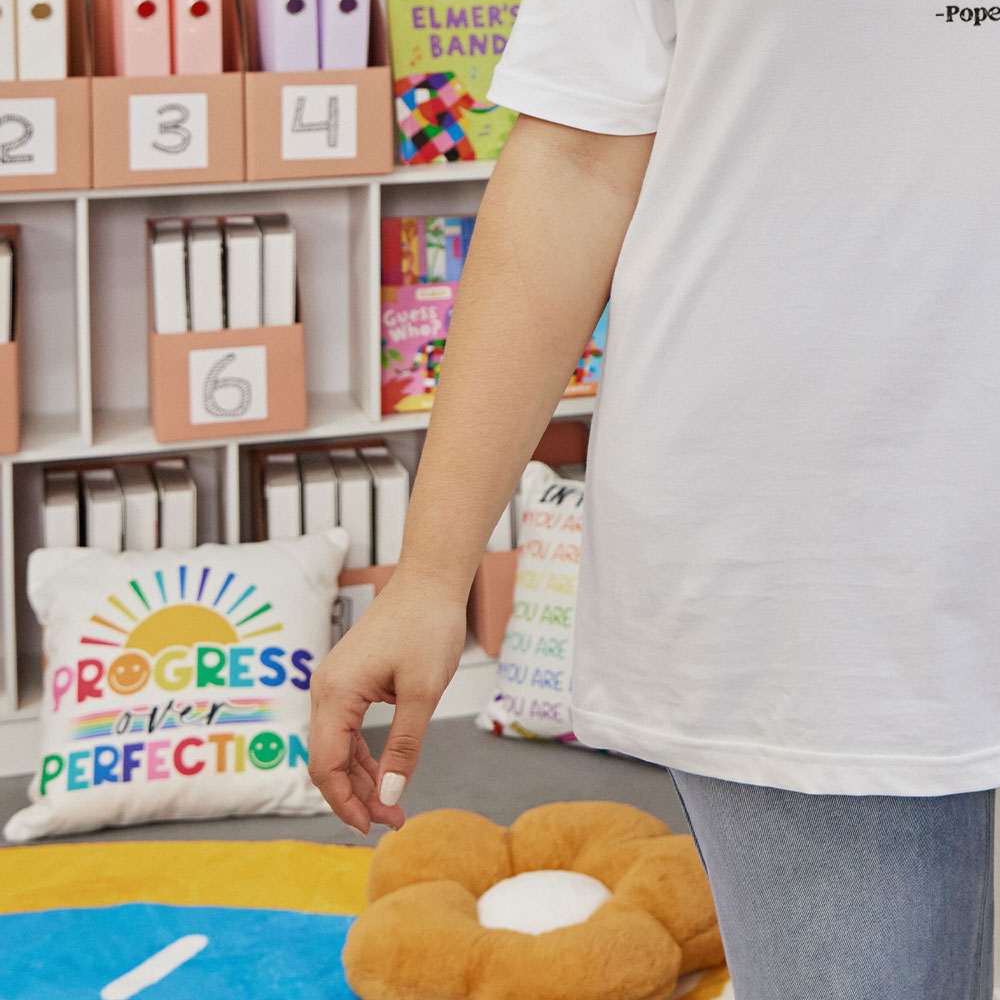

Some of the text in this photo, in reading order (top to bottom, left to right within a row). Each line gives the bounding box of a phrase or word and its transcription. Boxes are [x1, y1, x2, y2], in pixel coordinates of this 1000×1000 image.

[430, 34, 507, 58] BAND
[0, 114, 34, 163] 2
[152, 103, 192, 155] 3
[291, 96, 339, 147] 4
[382, 305, 437, 328] Guess
[388, 320, 442, 343] Who?
[204, 352, 252, 417] 6
[52, 646, 314, 712] PROGRESS
[115, 698, 255, 736] over
[40, 730, 309, 797] PERFECTION
